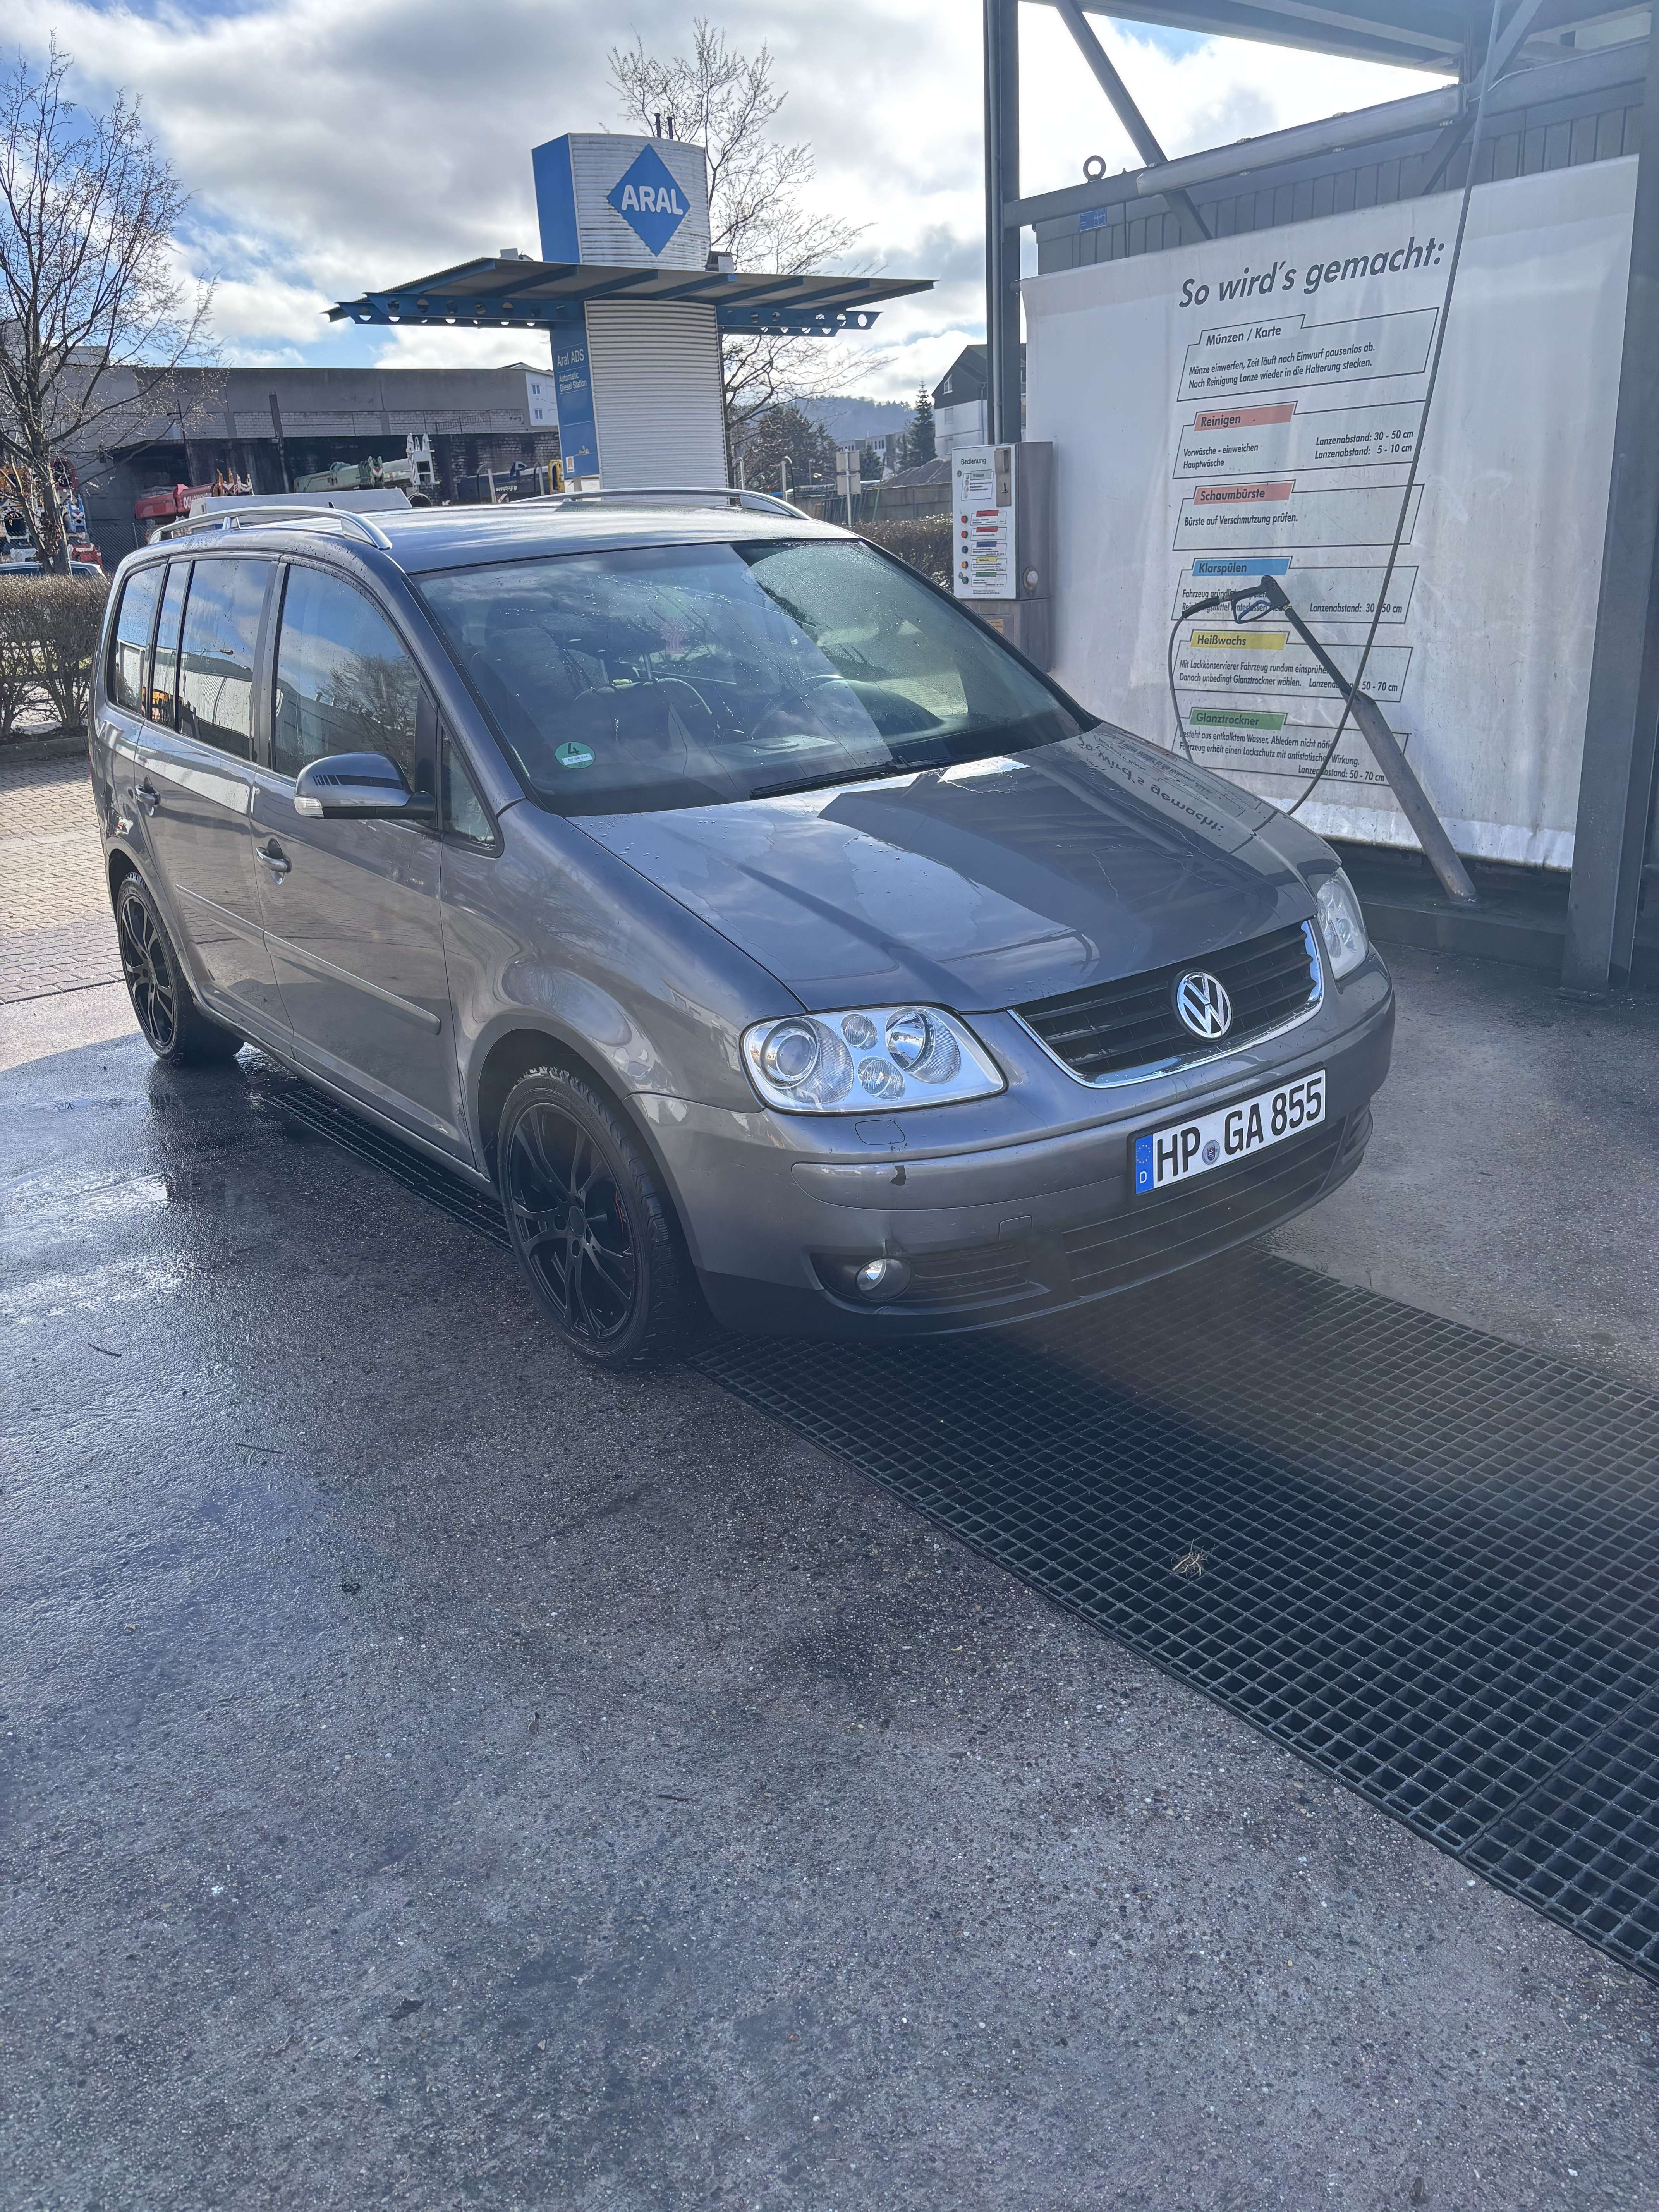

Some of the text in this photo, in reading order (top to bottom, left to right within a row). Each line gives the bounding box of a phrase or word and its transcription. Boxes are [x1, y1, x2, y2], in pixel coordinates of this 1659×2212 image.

[622, 184, 683, 215] ARAL
[1179, 278, 1209, 308] So
[1304, 236, 1444, 294] gemacht:
[1206, 326, 1281, 346] Münzen / Karte
[557, 349, 584, 367] Aral ADS
[1189, 342, 1375, 376] Münze einwerfen, Zeit läuft nach Einwurf pausenlos ab.
[1189, 358, 1372, 388] Nach Reinigung Lanze wieder in die Halterung stecken.
[573, 380, 587, 389] Station
[1201, 415, 1241, 428] Reinigen
[1316, 432, 1372, 446] Lanzenabstand:
[1374, 431, 1384, 441] 30
[1391, 430, 1401, 439] 50
[1184, 447, 1216, 457] Vorwäsche
[1223, 443, 1258, 453] einweichen
[1315, 446, 1371, 459] Lanzenabstand:
[1377, 445, 1382, 454] 5
[1391, 444, 1400, 453] 10
[1183, 458, 1224, 470] Hauptwäsche
[1200, 488, 1265, 501] Schaumbürste
[1184, 512, 1298, 526] Bürste auf Verschmutzung prüfen.
[1199, 562, 1247, 575] Klarspülen
[1182, 589, 1237, 599] Fahrzeug gründli
[1310, 603, 1362, 613] Lanzenabstand:
[1366, 603, 1375, 613] 30
[1382, 603, 1391, 613] 50
[1197, 635, 1246, 646] Heißwachs
[1180, 659, 1328, 675] Mit Lackkonservierer Fahrzeug rundum einsprühe
[1180, 672, 1301, 687] Danach unbedingt Glanztrockner wählen.
[1362, 681, 1370, 690] 50
[1378, 682, 1386, 691] 70
[1197, 713, 1259, 725] Glanztrockner
[1180, 730, 1200, 738] esteht
[1213, 732, 1245, 742] entkalktem
[1247, 734, 1269, 744] Wasser.
[1271, 736, 1298, 746] Abledern
[1300, 738, 1316, 748] nicht
[1317, 740, 1332, 749] nöti
[568, 743, 579, 754] 4
[1207, 744, 1224, 753] erhält
[1225, 745, 1241, 754] einen
[1243, 747, 1275, 757] Lackschutz
[1276, 750, 1286, 759] mit
[1288, 751, 1326, 762] antistatische
[1331, 754, 1360, 767] Wirkung.
[1298, 765, 1348, 778] Lanzenbstand:
[1350, 770, 1358, 779] 50
[1365, 771, 1373, 781] 70
[1375, 774, 1384, 782] cm
[1157, 1077, 1322, 1182] HP GA 855
[1139, 1171, 1147, 1184] D
